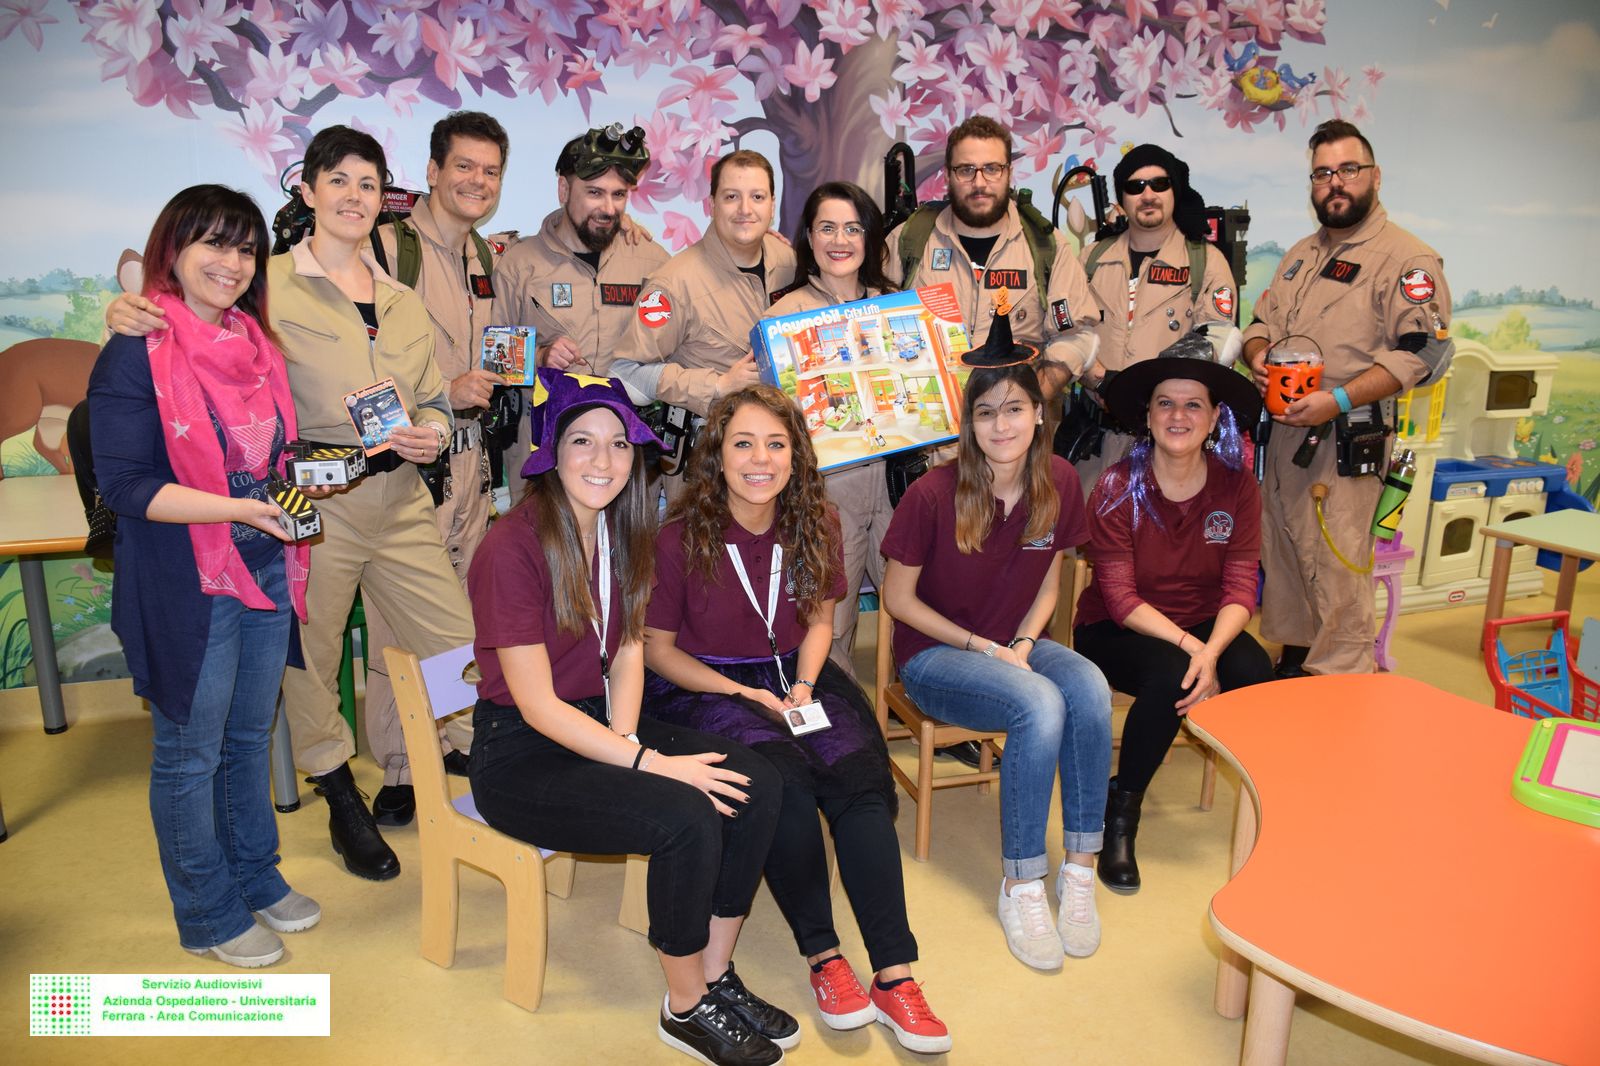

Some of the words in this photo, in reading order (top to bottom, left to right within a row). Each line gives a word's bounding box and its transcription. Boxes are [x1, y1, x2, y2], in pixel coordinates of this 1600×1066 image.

[1151, 267, 1188, 283] VIANELLO
[1331, 262, 1354, 278] TOY
[990, 271, 1020, 287] BOTTA
[767, 308, 842, 339] playmobil
[844, 306, 863, 320] City
